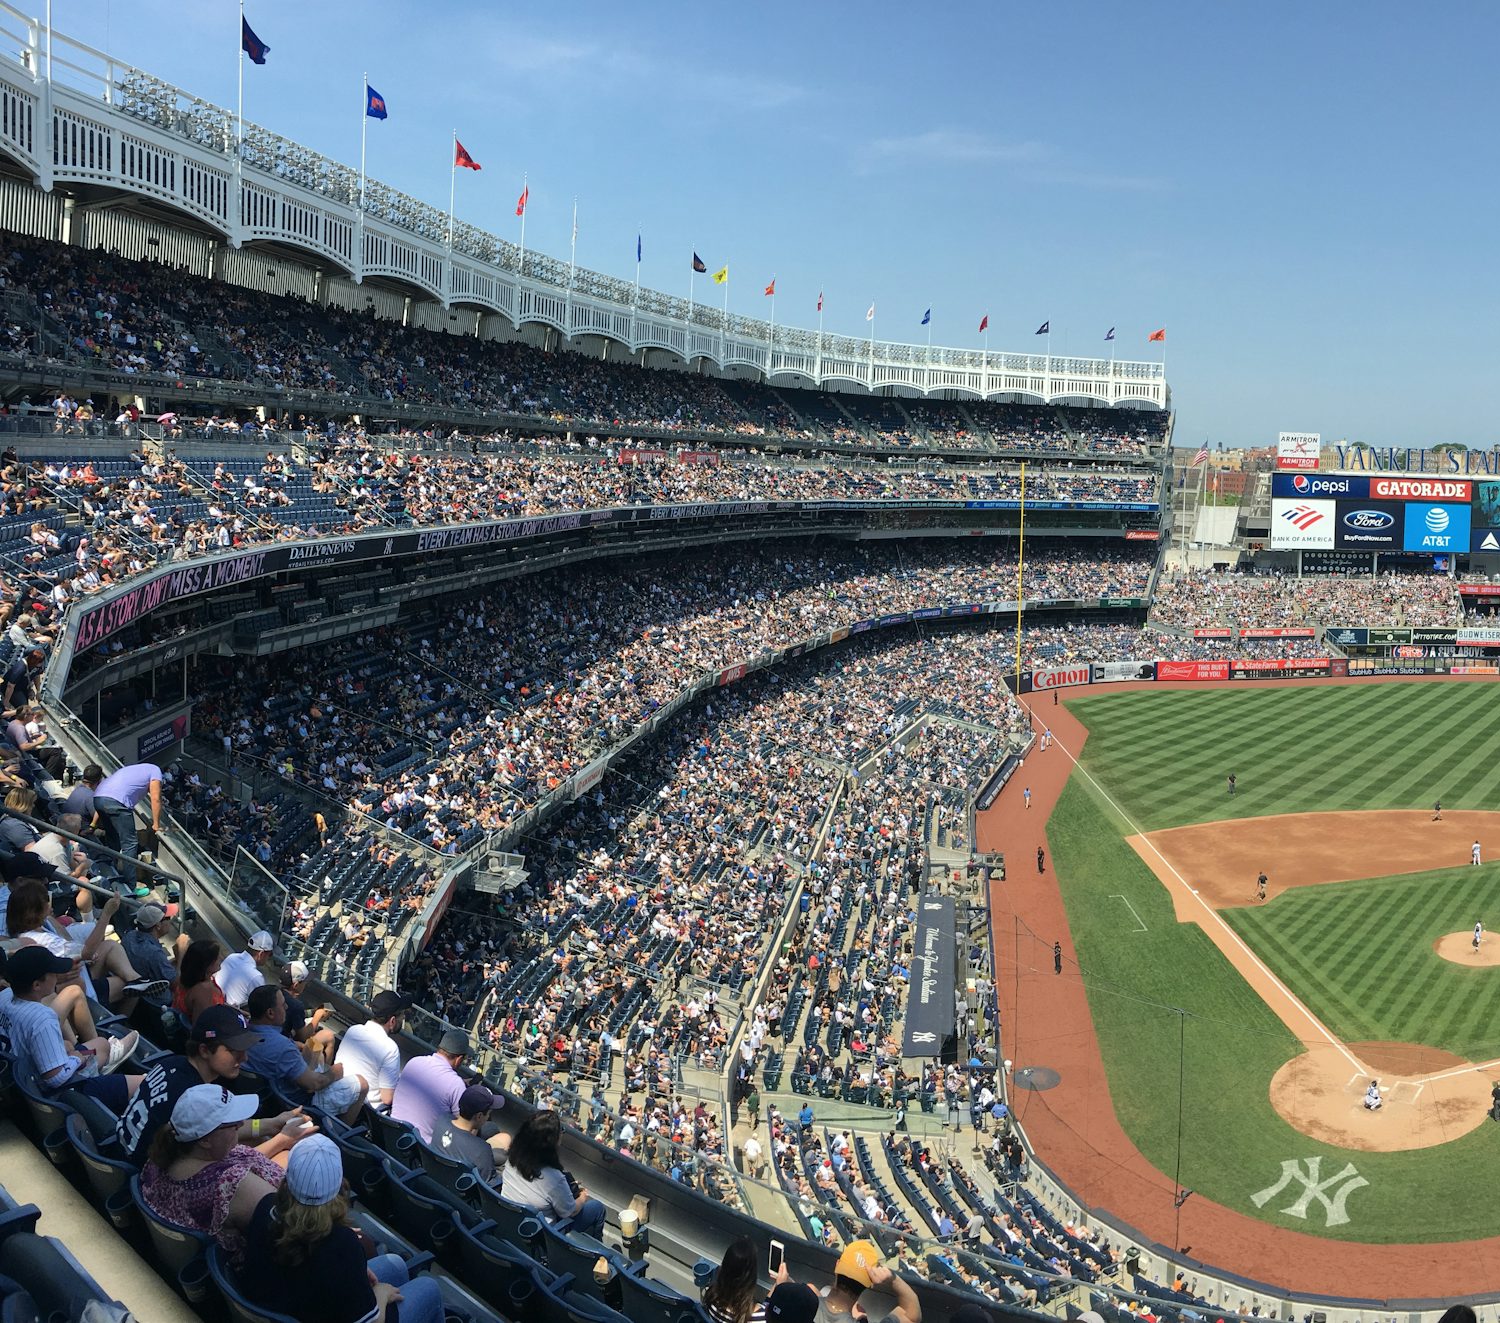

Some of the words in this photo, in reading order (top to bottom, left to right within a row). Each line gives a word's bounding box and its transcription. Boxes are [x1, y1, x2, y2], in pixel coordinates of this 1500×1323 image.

[1336, 445, 1437, 473] YANKEE
[1312, 480, 1349, 494] pepsi
[1376, 481, 1466, 497] GATORADE
[1353, 512, 1384, 527] Ford
[417, 532, 449, 550] EVERY
[450, 528, 473, 545] TEAM
[473, 526, 490, 543] HAS
[496, 523, 520, 538] STORY.
[521, 519, 543, 535] DON'T
[1422, 535, 1452, 547] AT&T
[289, 547, 322, 560] DAILY
[325, 542, 356, 556] NEWS
[76, 611, 97, 649] AS
[94, 607, 105, 641] A
[105, 591, 142, 633] STORY.
[141, 575, 170, 613] DON'T
[169, 567, 202, 597] MISS
[202, 565, 212, 589] A
[215, 553, 266, 584] MOMENT.
[1458, 630, 1500, 638] BUDWEISER
[1033, 668, 1089, 688] Canon
[1250, 1155, 1371, 1227] NY
